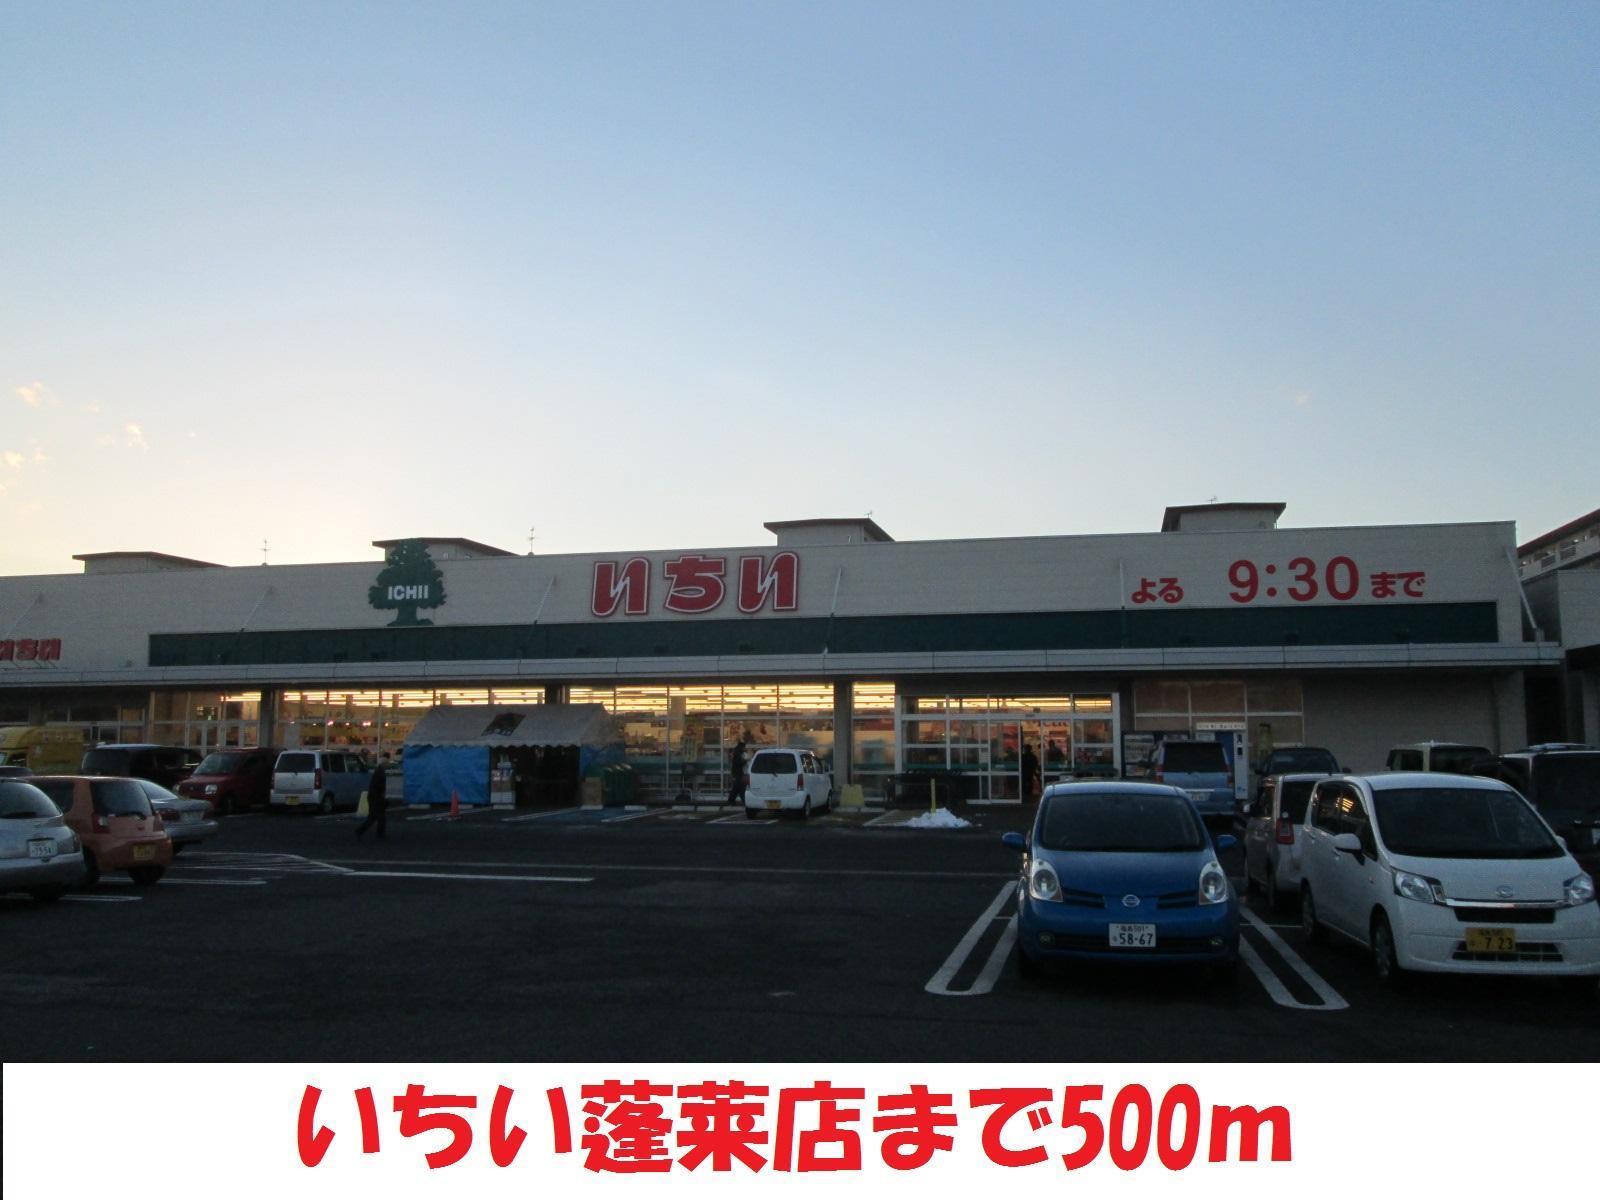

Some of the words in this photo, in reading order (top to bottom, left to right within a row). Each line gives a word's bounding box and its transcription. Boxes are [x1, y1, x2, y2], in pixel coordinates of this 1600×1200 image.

[387, 584, 430, 601] ICHII
[592, 551, 799, 617] いちい
[1133, 578, 1183, 604] よる
